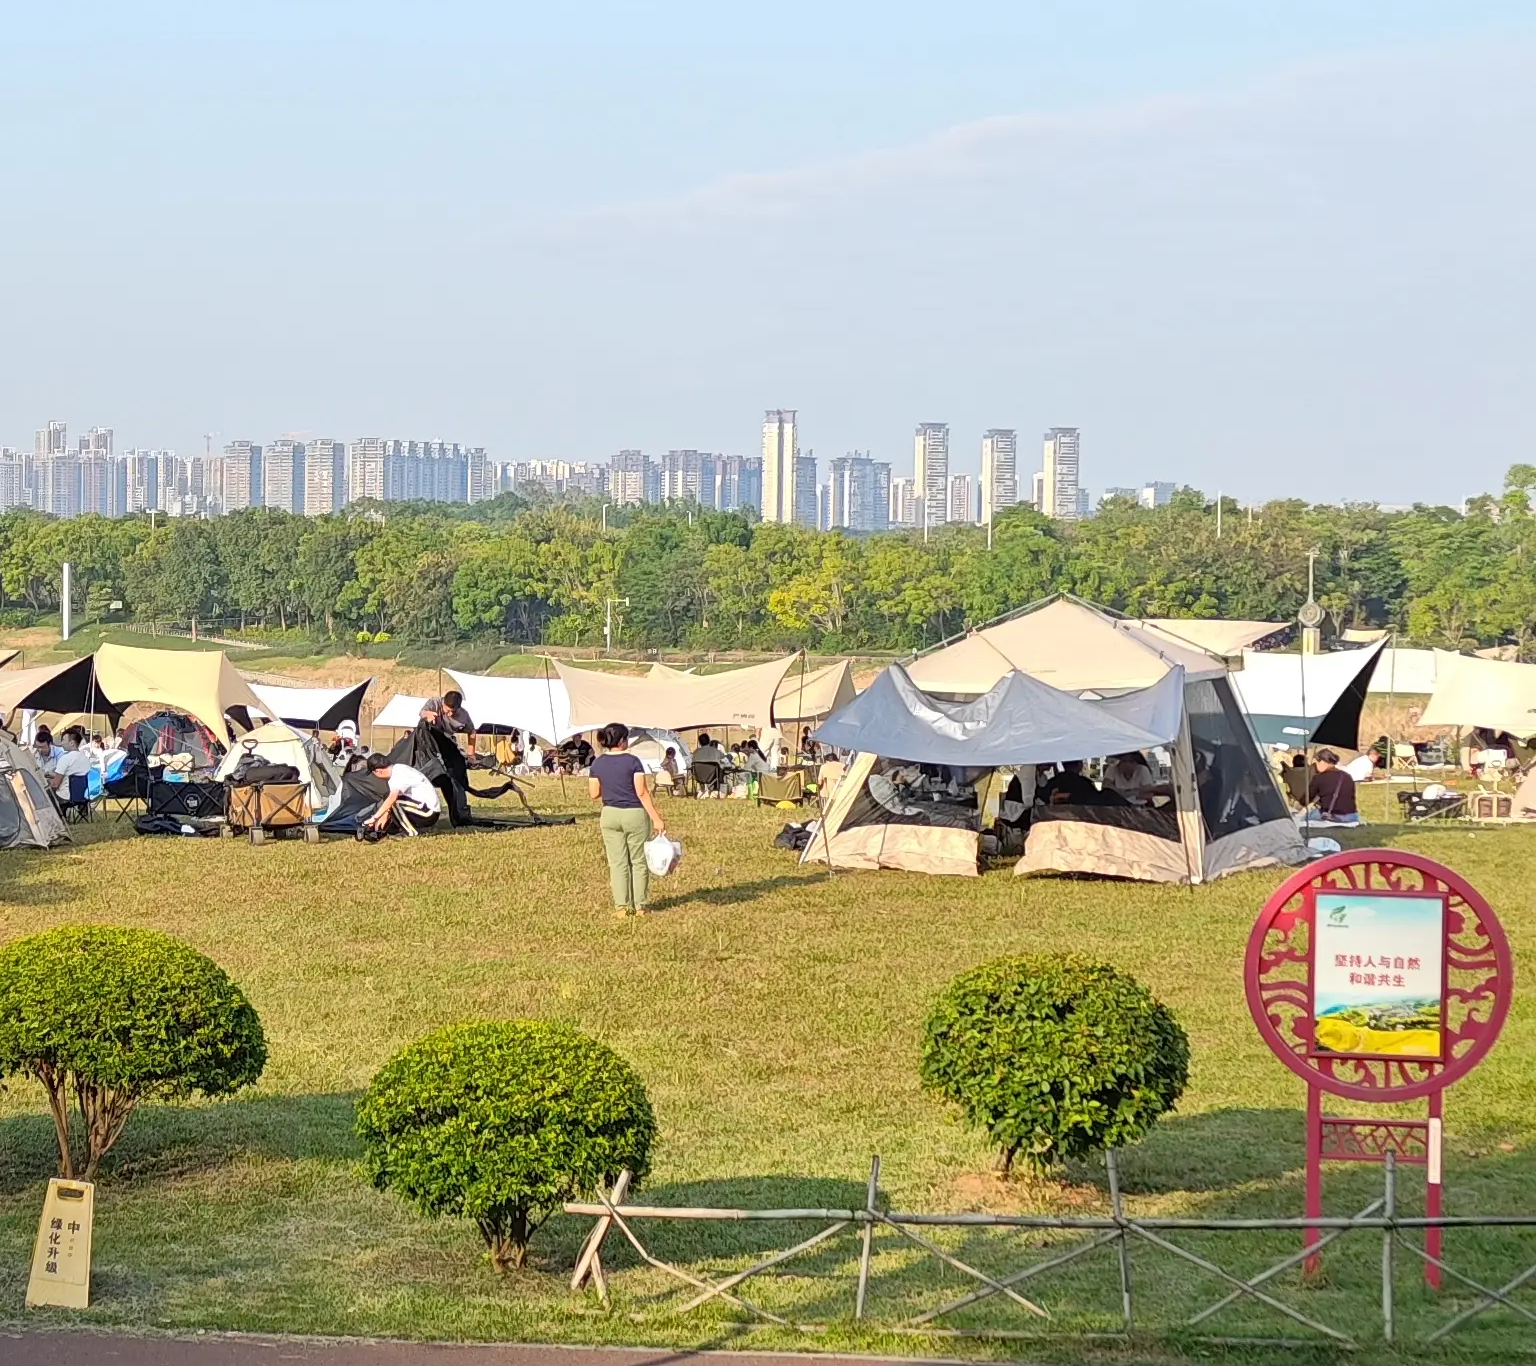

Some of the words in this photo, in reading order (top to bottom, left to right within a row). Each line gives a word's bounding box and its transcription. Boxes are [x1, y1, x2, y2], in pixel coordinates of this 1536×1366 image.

[1334, 954, 1421, 971] 坚持人与自然
[1349, 972, 1406, 988] 和谐共生
[45, 1217, 63, 1274] 绿化升级
